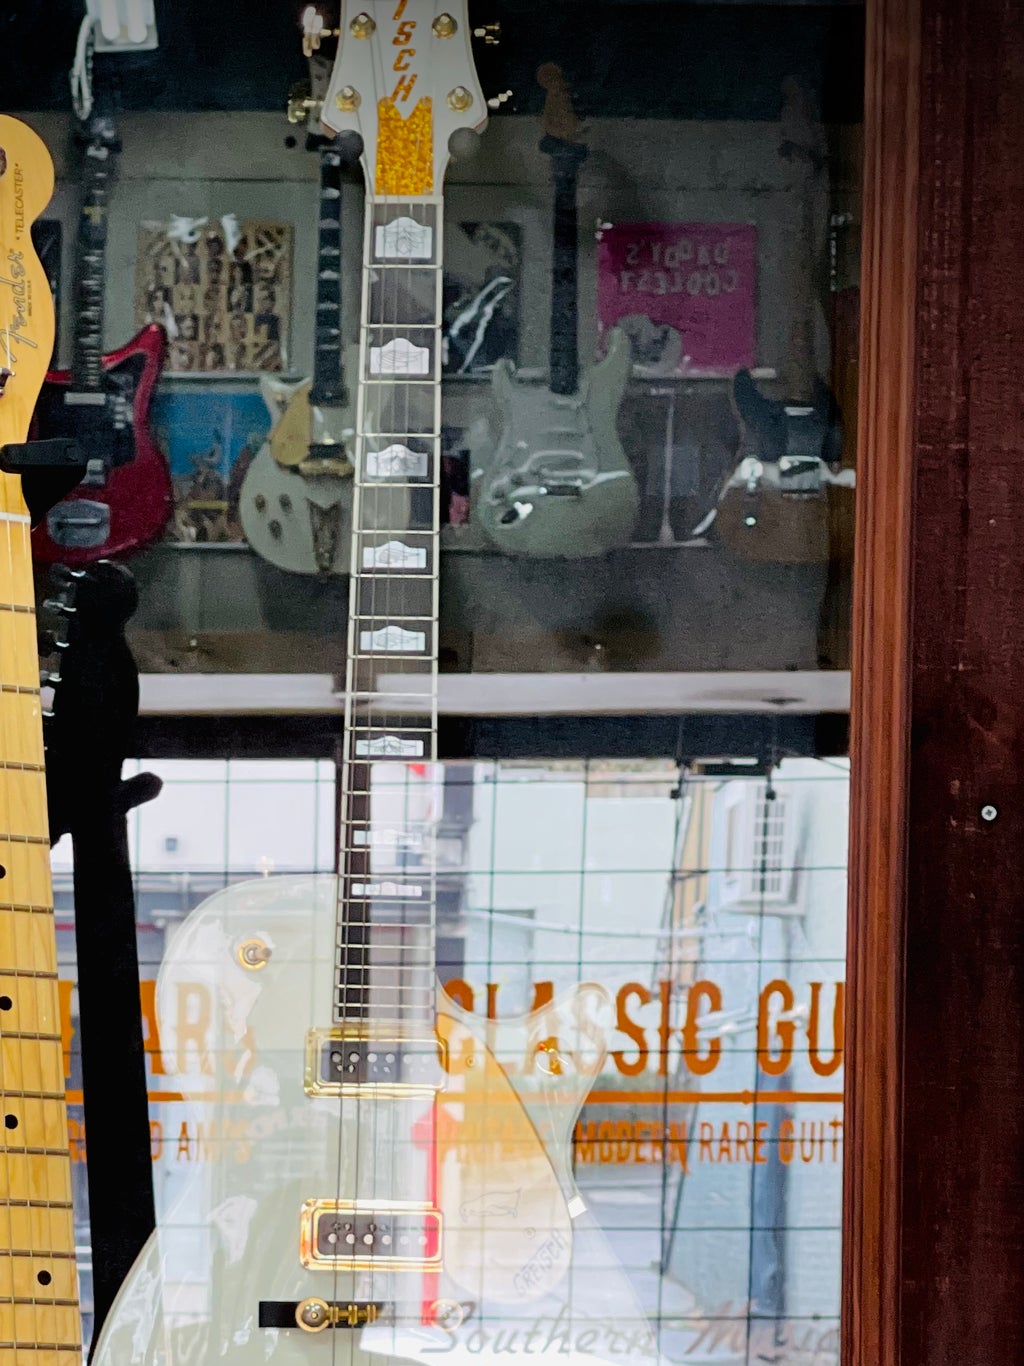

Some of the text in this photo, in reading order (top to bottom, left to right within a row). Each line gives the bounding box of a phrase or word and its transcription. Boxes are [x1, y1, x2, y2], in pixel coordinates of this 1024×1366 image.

[575, 1120, 691, 1176] MODERN
[699, 1120, 767, 1164] RARE
[420, 1300, 658, 1357] Southern
